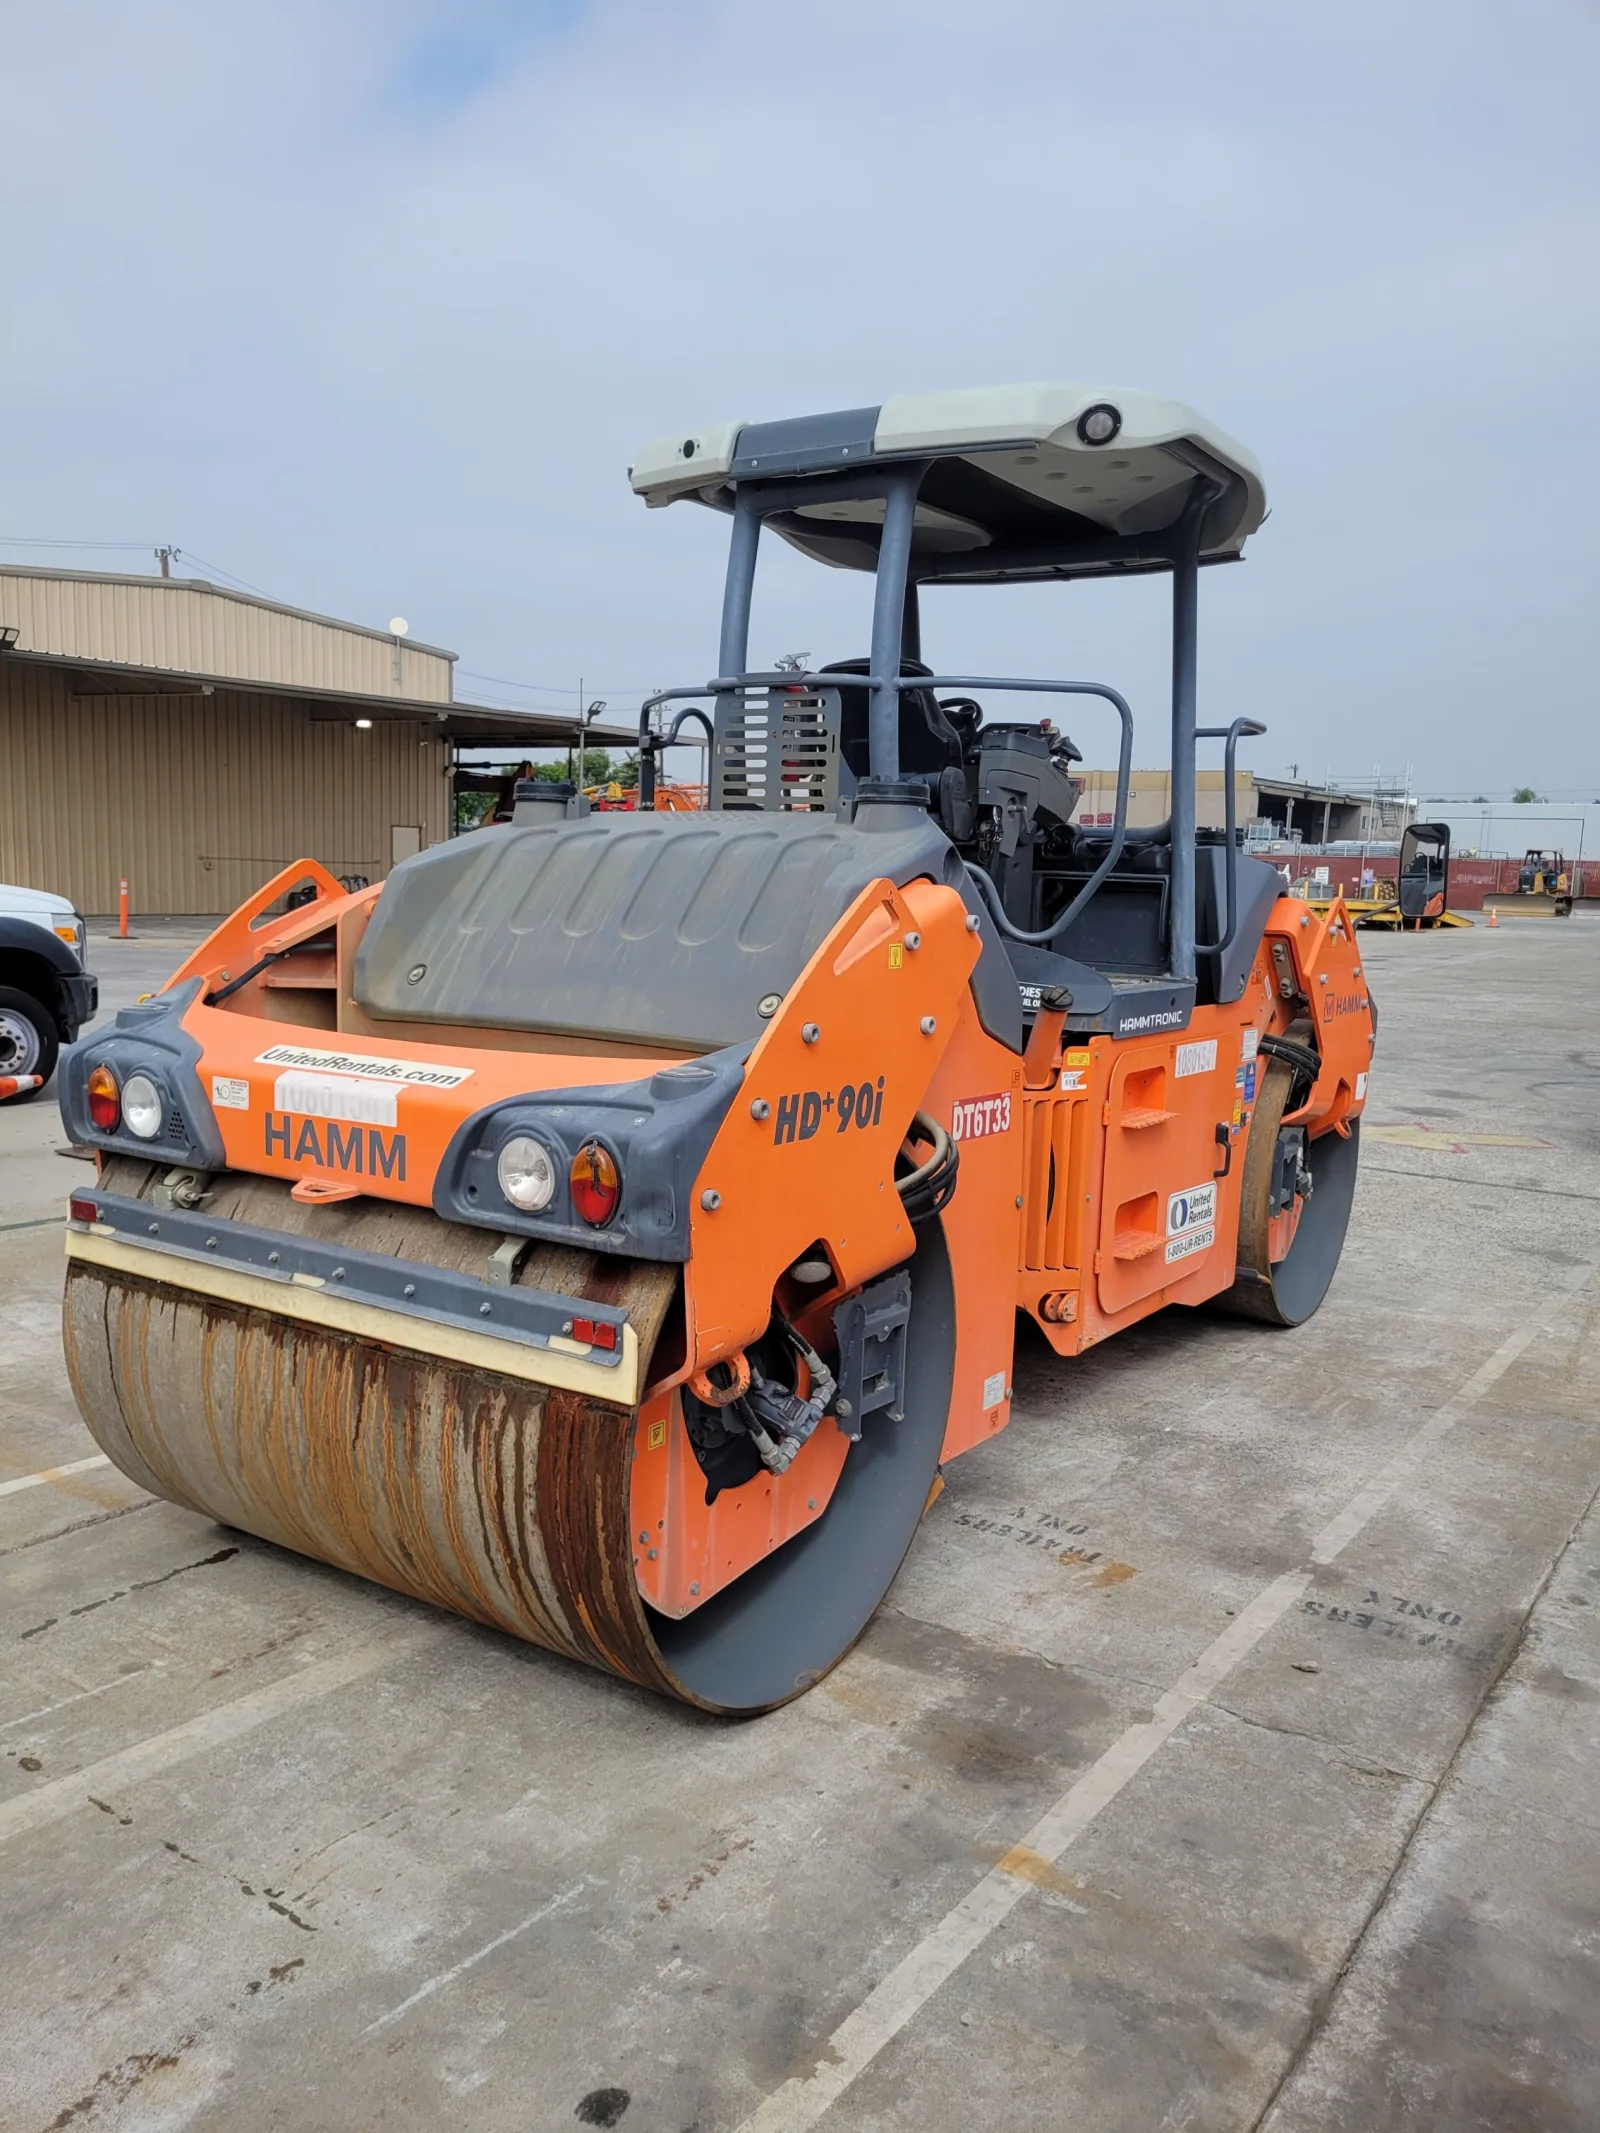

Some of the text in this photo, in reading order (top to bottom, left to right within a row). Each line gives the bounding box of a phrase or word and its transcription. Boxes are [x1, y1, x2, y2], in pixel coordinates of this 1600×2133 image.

[1119, 1010, 1183, 1032] HAMMTRONIC
[262, 1048, 462, 1087] UnitedRentals.com
[953, 1096, 1011, 1141] DT6T33
[265, 1112, 406, 1182] HAMM
[1189, 1189, 1212, 1209] United
[1188, 1206, 1212, 1224] Rentals
[1167, 1230, 1213, 1258] 1-800-UR-RENTS
